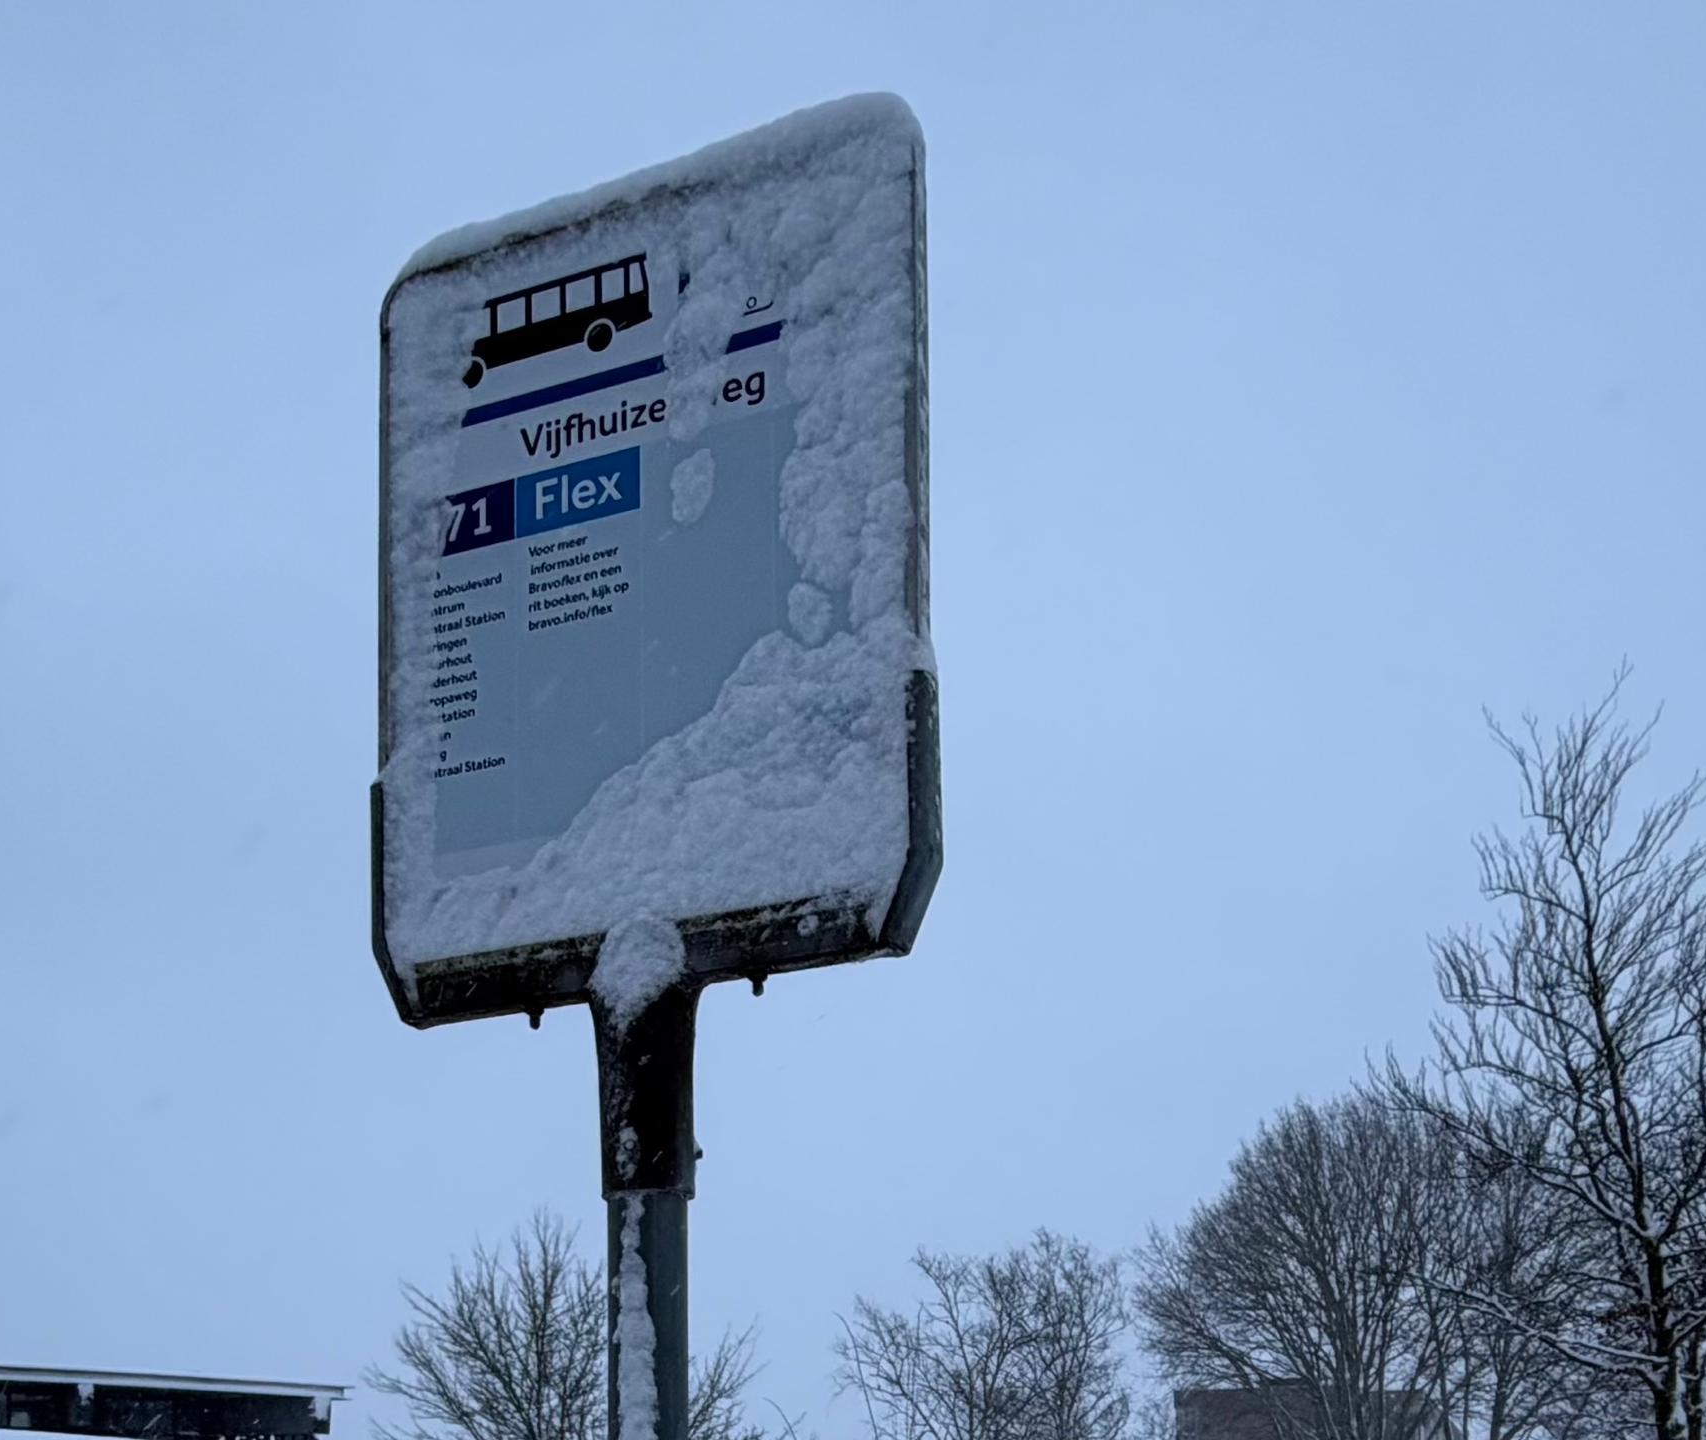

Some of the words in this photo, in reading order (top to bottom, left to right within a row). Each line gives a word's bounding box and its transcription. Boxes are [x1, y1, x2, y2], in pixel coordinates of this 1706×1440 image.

[520, 370, 766, 459] Vijfhuizeeg
[535, 471, 623, 520] Flex
[528, 543, 555, 557] Voor
[557, 535, 588, 551] meer
[530, 552, 591, 576] informatie
[592, 546, 619, 561] over
[528, 574, 582, 595] Bravoflex
[583, 570, 598, 582] en
[600, 565, 622, 578] een
[528, 600, 542, 613] rit
[543, 591, 590, 610] boeken,
[591, 584, 612, 600] kijk
[613, 581, 630, 594] op
[465, 610, 506, 628] Station
[528, 603, 613, 631] bravo.info/flex
[465, 756, 506, 773] Station
